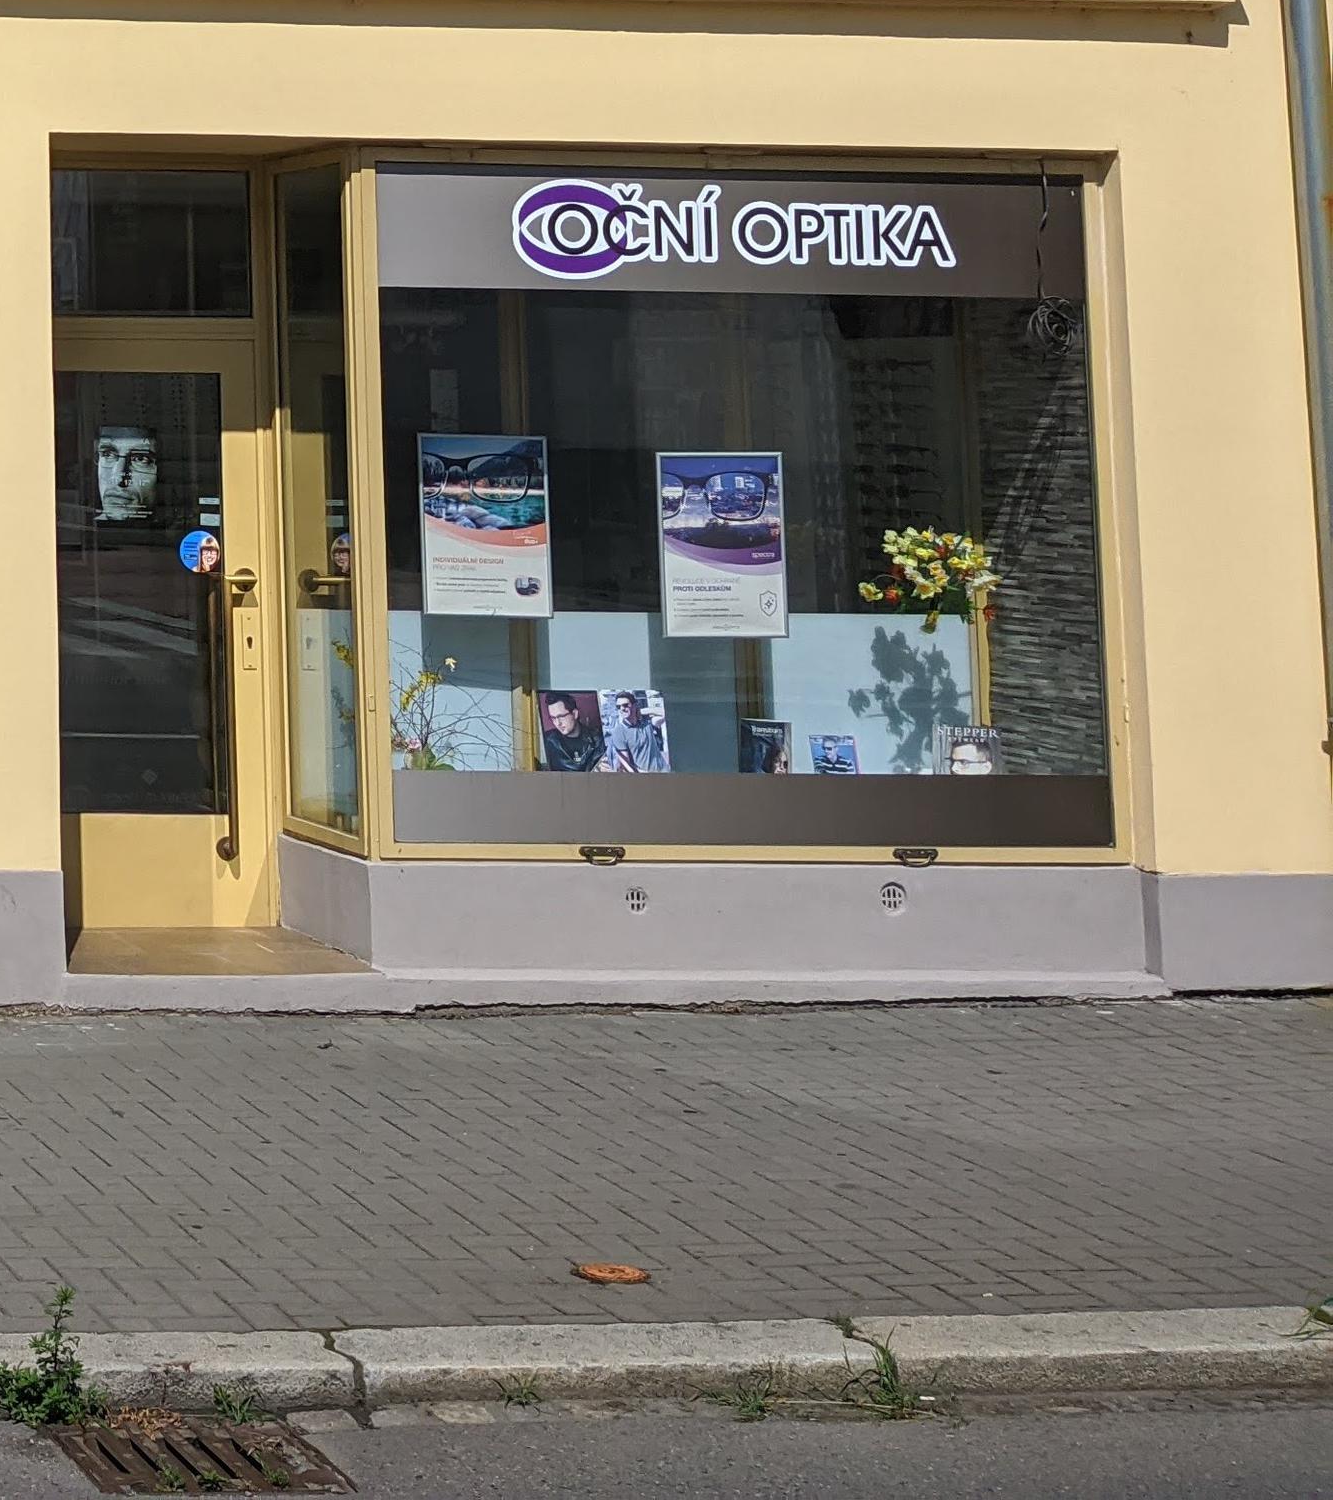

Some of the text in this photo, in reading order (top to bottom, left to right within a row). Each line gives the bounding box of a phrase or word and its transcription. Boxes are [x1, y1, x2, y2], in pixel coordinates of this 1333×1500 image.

[544, 184, 956, 266] OČNÍ OPTIKA
[937, 726, 1001, 739] STEPPER
